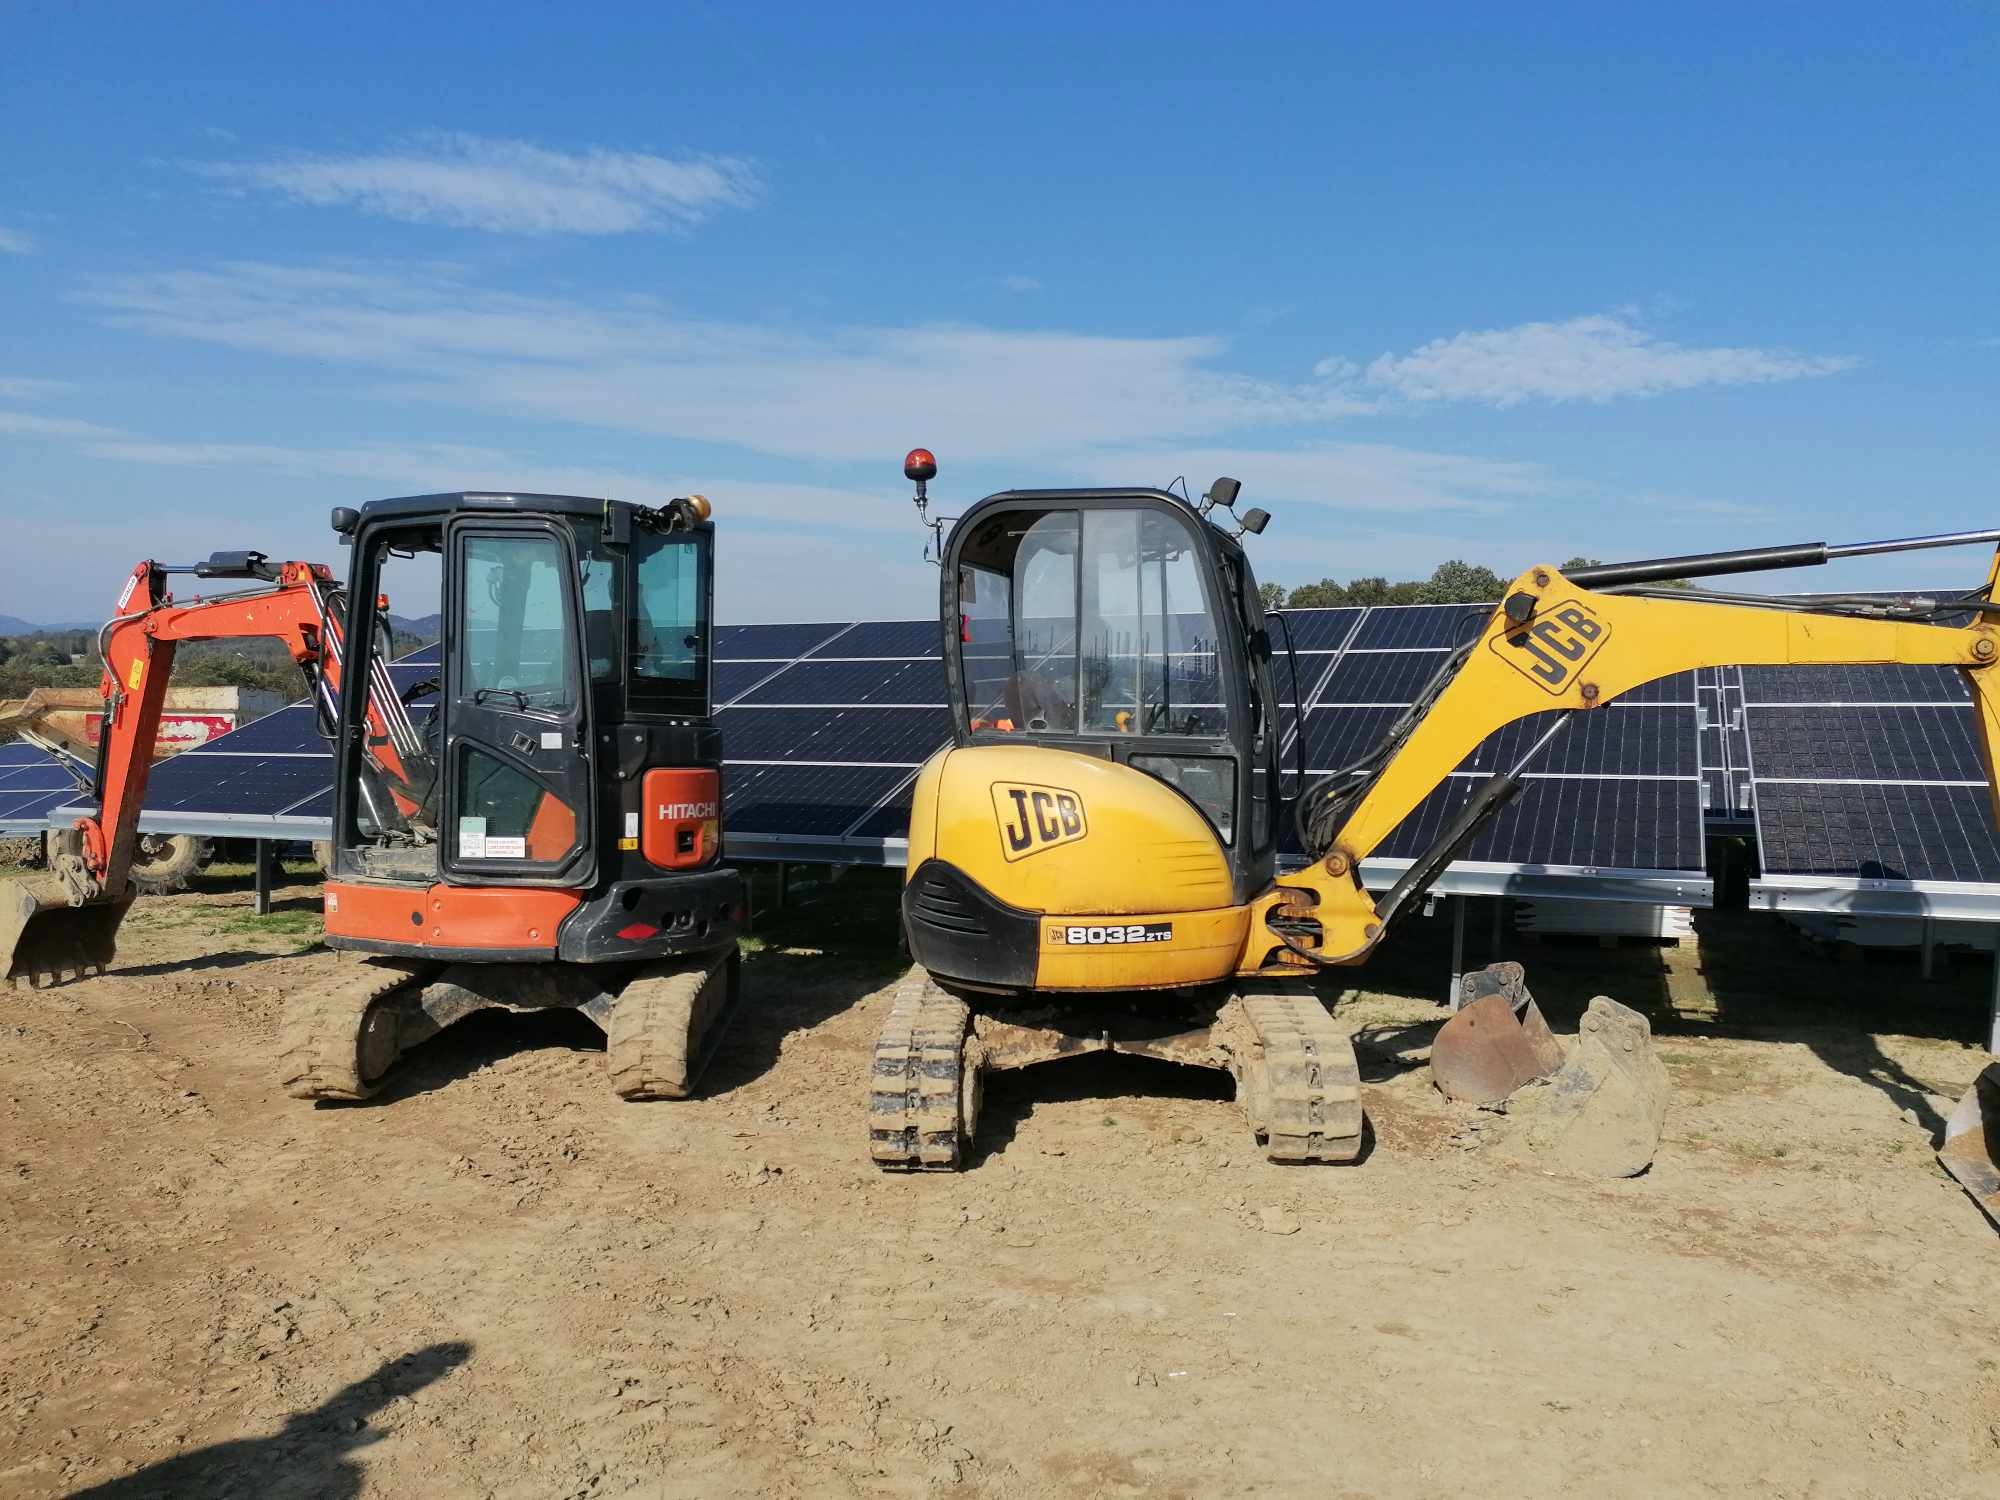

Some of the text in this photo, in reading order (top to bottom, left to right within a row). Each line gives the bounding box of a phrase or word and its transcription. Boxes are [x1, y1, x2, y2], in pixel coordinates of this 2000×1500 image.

[1507, 608, 1602, 685] JCB
[658, 802, 716, 820] HITACHI
[1006, 789, 1081, 852] JCB
[1067, 926, 1146, 944] 8032
[1146, 932, 1171, 941] ZTS
